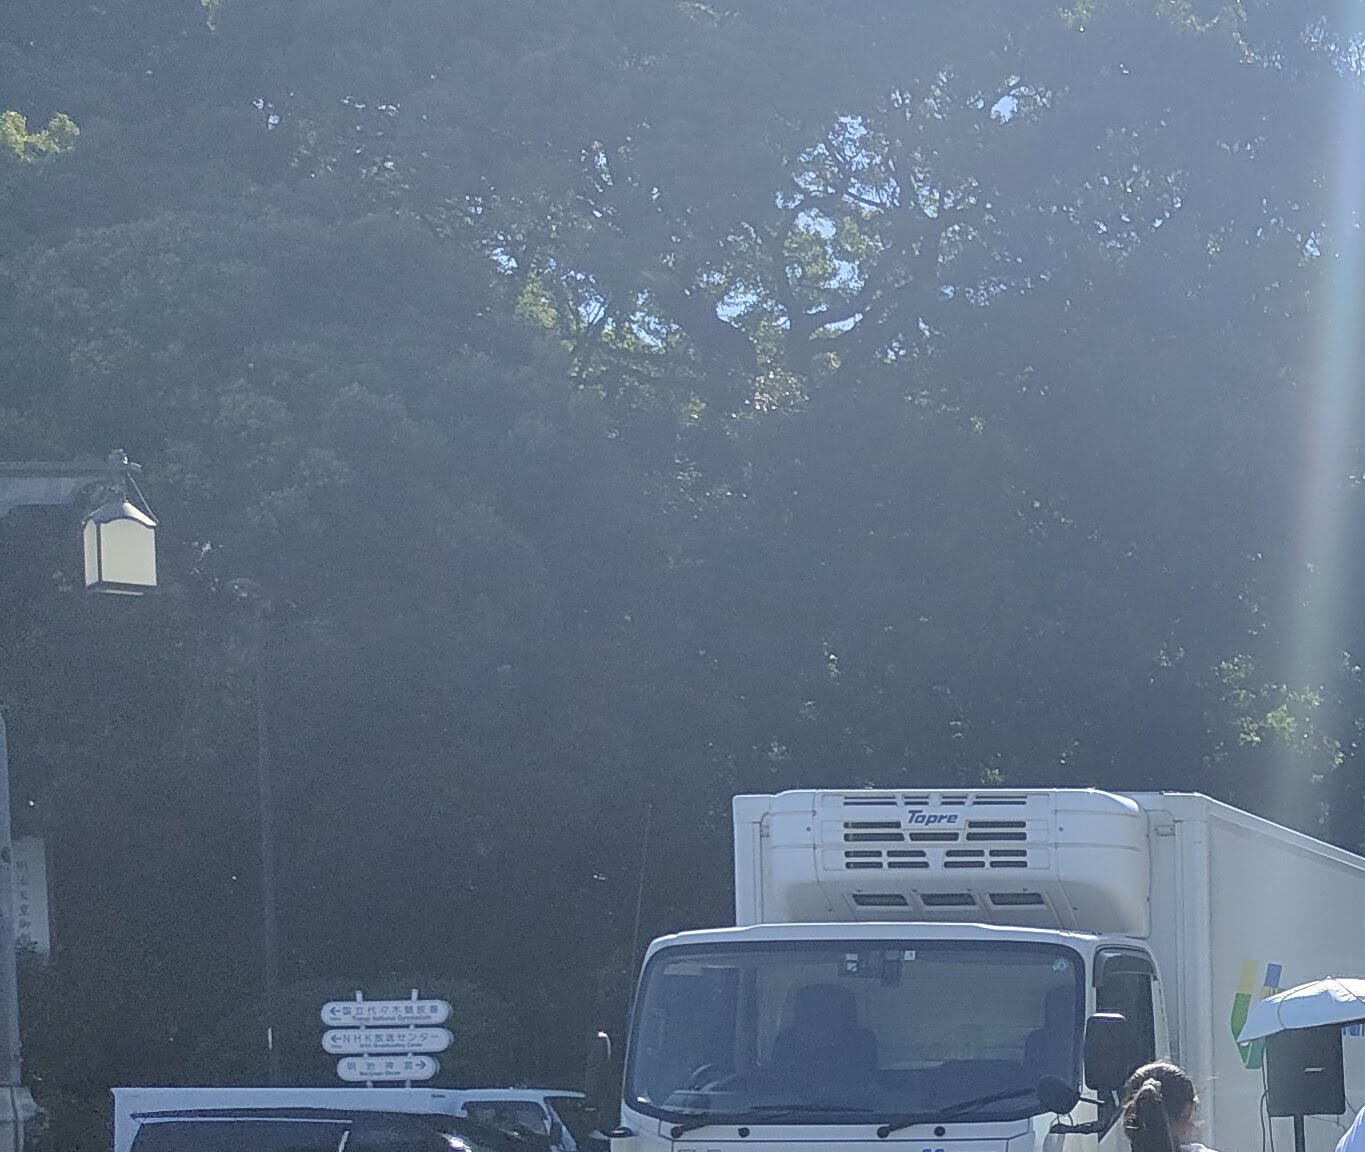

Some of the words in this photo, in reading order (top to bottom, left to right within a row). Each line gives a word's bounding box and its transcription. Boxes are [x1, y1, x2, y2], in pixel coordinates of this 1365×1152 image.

[908, 809, 959, 826] Topre
[346, 1061, 413, 1071] 明治神宮
